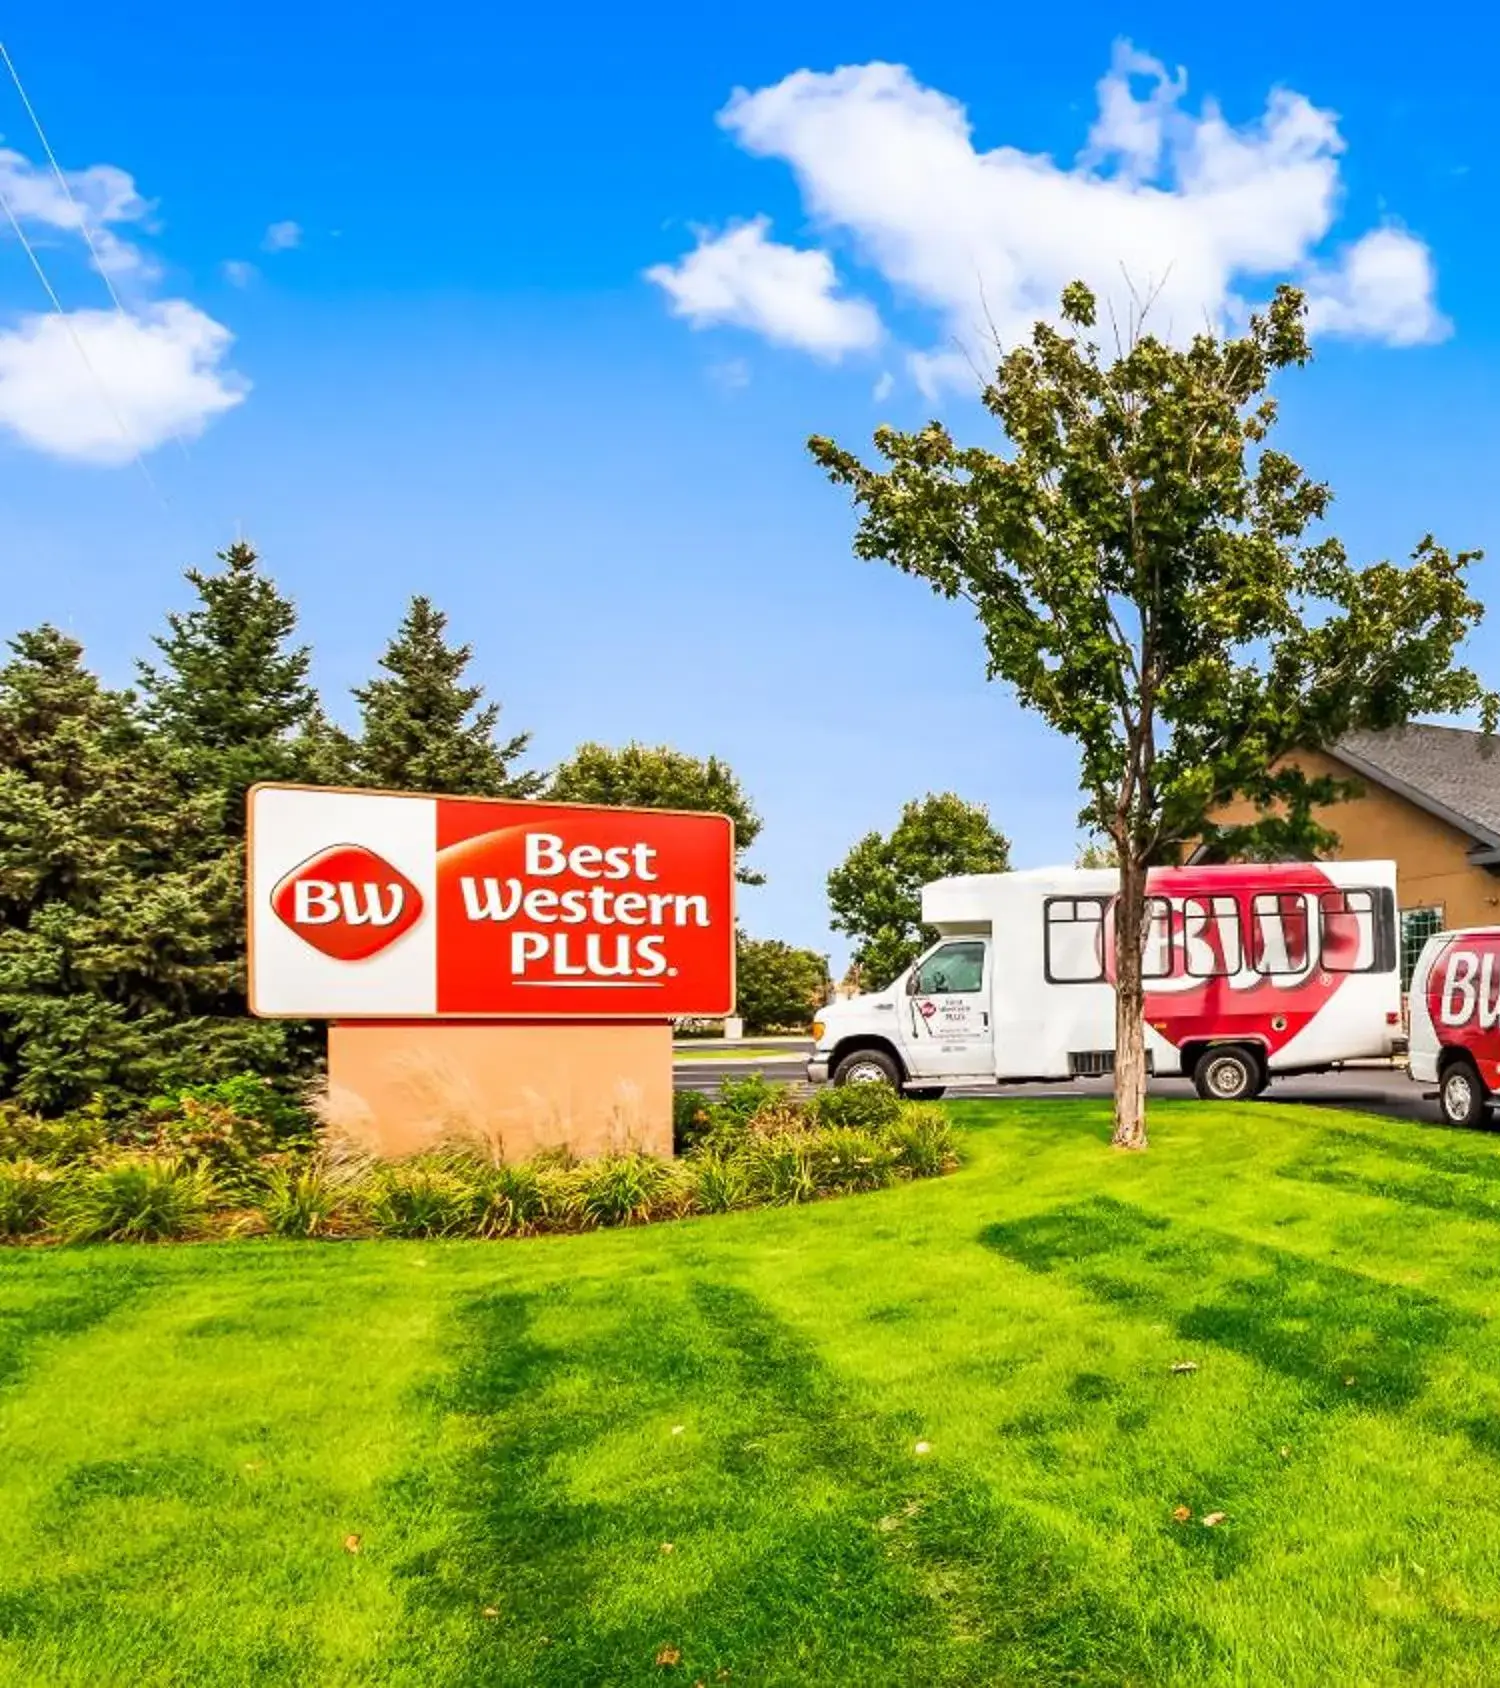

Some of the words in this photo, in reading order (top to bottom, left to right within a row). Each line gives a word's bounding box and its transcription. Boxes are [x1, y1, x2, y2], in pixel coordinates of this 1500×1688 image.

[525, 832, 657, 881] Best
[293, 878, 403, 927] BW
[460, 875, 711, 927] Western
[1141, 893, 1321, 991] BW
